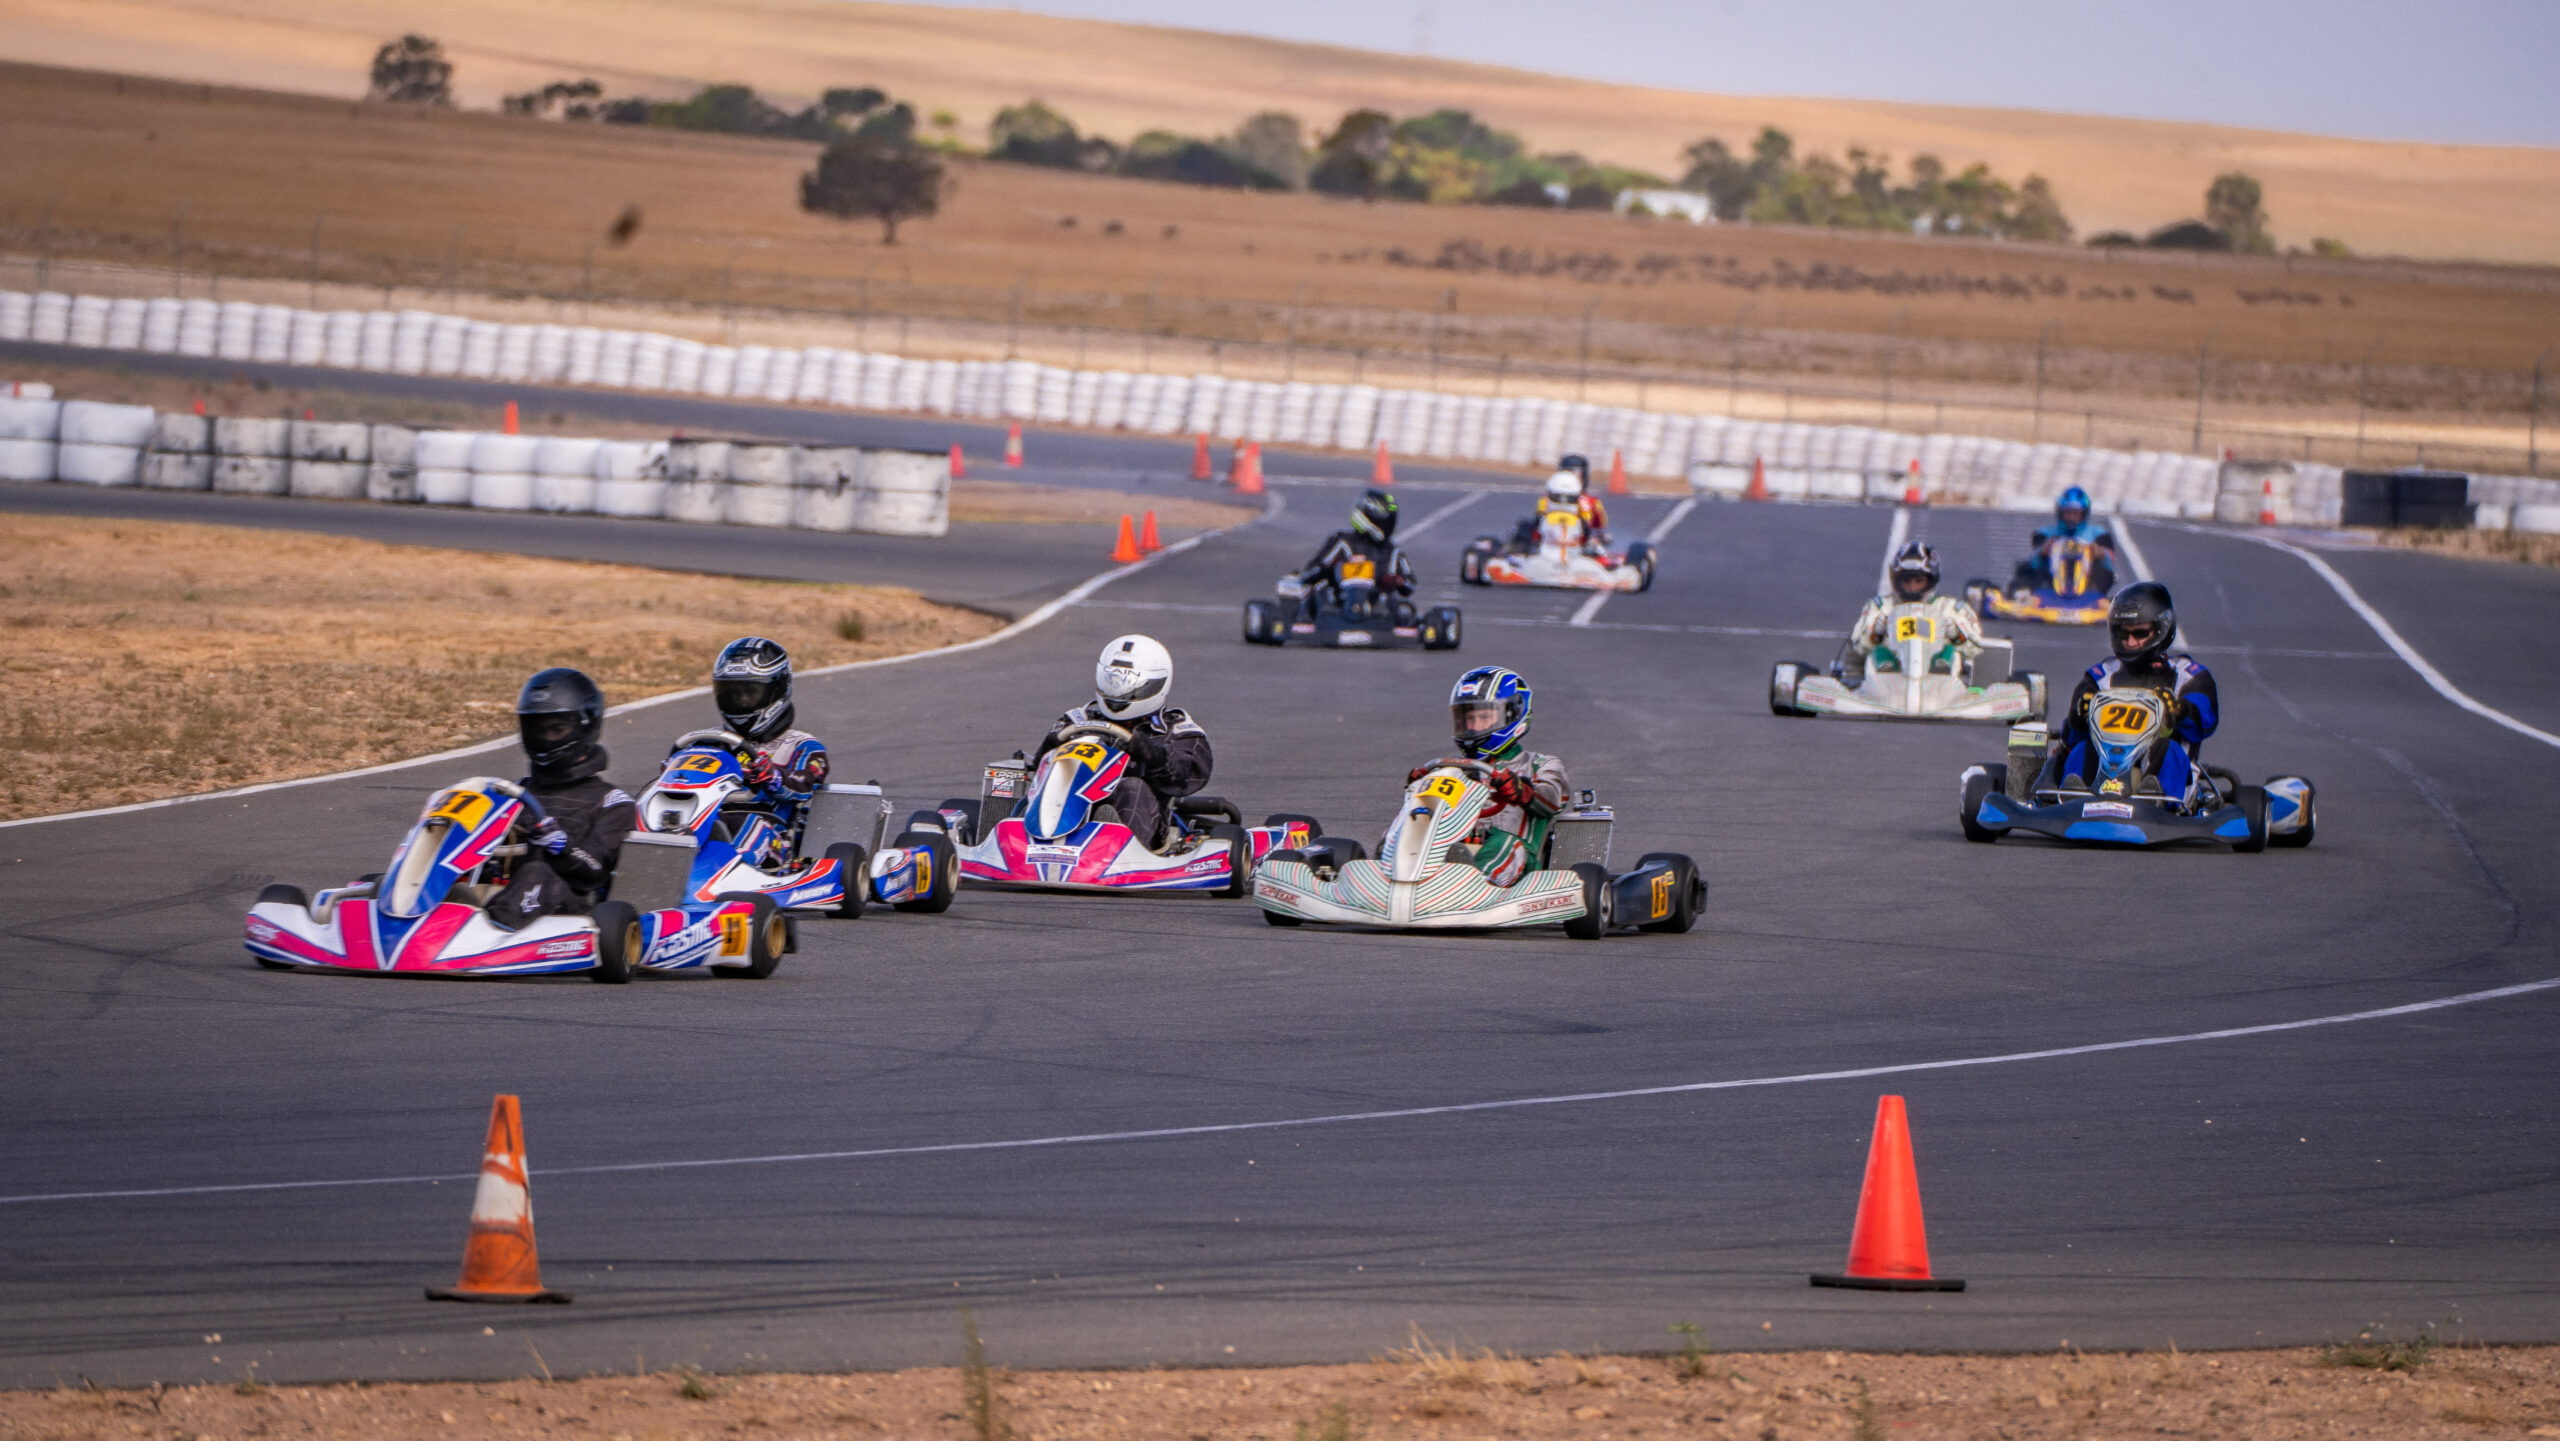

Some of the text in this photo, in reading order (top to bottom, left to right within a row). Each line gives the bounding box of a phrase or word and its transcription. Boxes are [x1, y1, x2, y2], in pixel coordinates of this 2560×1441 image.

[2103, 705, 2149, 731] 20
[1056, 743, 1101, 759] 33
[674, 755, 716, 770] 14
[1418, 778, 1457, 796] 85
